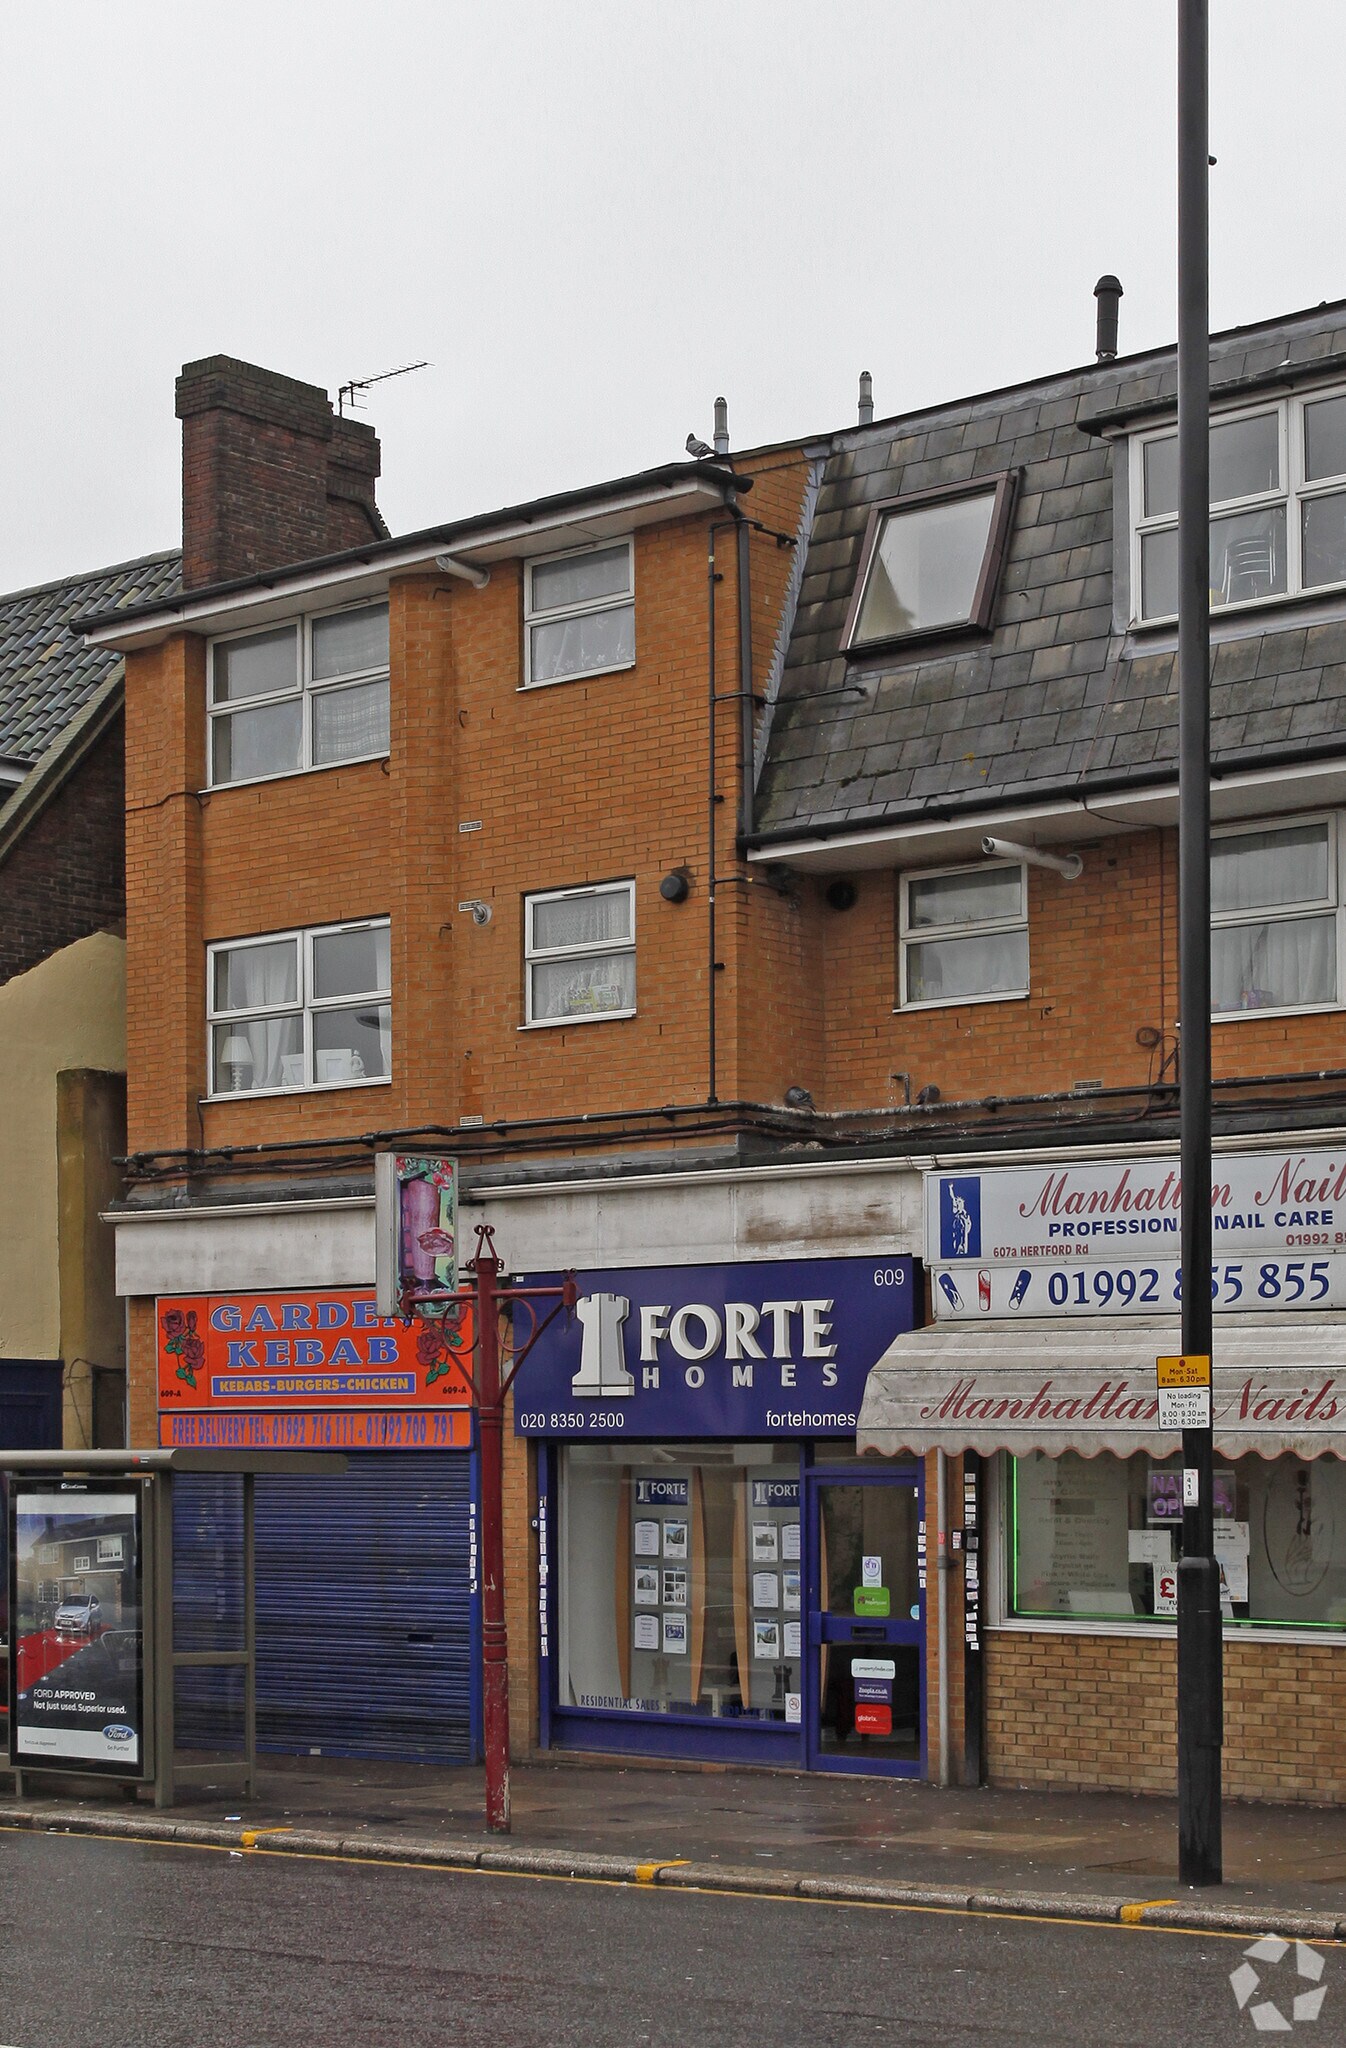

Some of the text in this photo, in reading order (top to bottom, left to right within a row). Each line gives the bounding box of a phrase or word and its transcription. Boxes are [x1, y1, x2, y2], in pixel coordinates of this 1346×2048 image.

[1019, 1168, 1233, 1218] Manhattn
[1048, 1210, 1333, 1238] PROFESSION NAIL CARE
[1285, 1231, 1346, 1246] 01992 8
[993, 1243, 1089, 1258] 607a HERTFORD Rd
[873, 1268, 905, 1287] 609
[1048, 1268, 1160, 1308] 01992
[1257, 1261, 1330, 1303] 855
[639, 1299, 838, 1362] FORTE
[226, 1336, 400, 1368] KEBAB
[642, 1363, 839, 1390] HOMES
[160, 1390, 182, 1398] 609-A
[442, 1386, 468, 1394] 609-A
[1178, 1392, 1201, 1400] loading
[1212, 1378, 1346, 1421] Nails
[520, 1410, 857, 1429] 020 8350 2500 fortehomes
[172, 1415, 454, 1444] FREE DELIVERY TEL: 01992 716 111 01992 700 791
[651, 1482, 686, 1495] FORTE
[768, 1484, 799, 1497] FORT
[33, 1689, 96, 1701] FORD APPROVED
[580, 1694, 633, 1710] RESIDENTIAL
[635, 1698, 660, 1712] SALES
[33, 1701, 45, 1709] Not
[77, 1703, 106, 1714] Superior
[107, 1705, 127, 1714] used.
[107, 1726, 129, 1740] Ford
